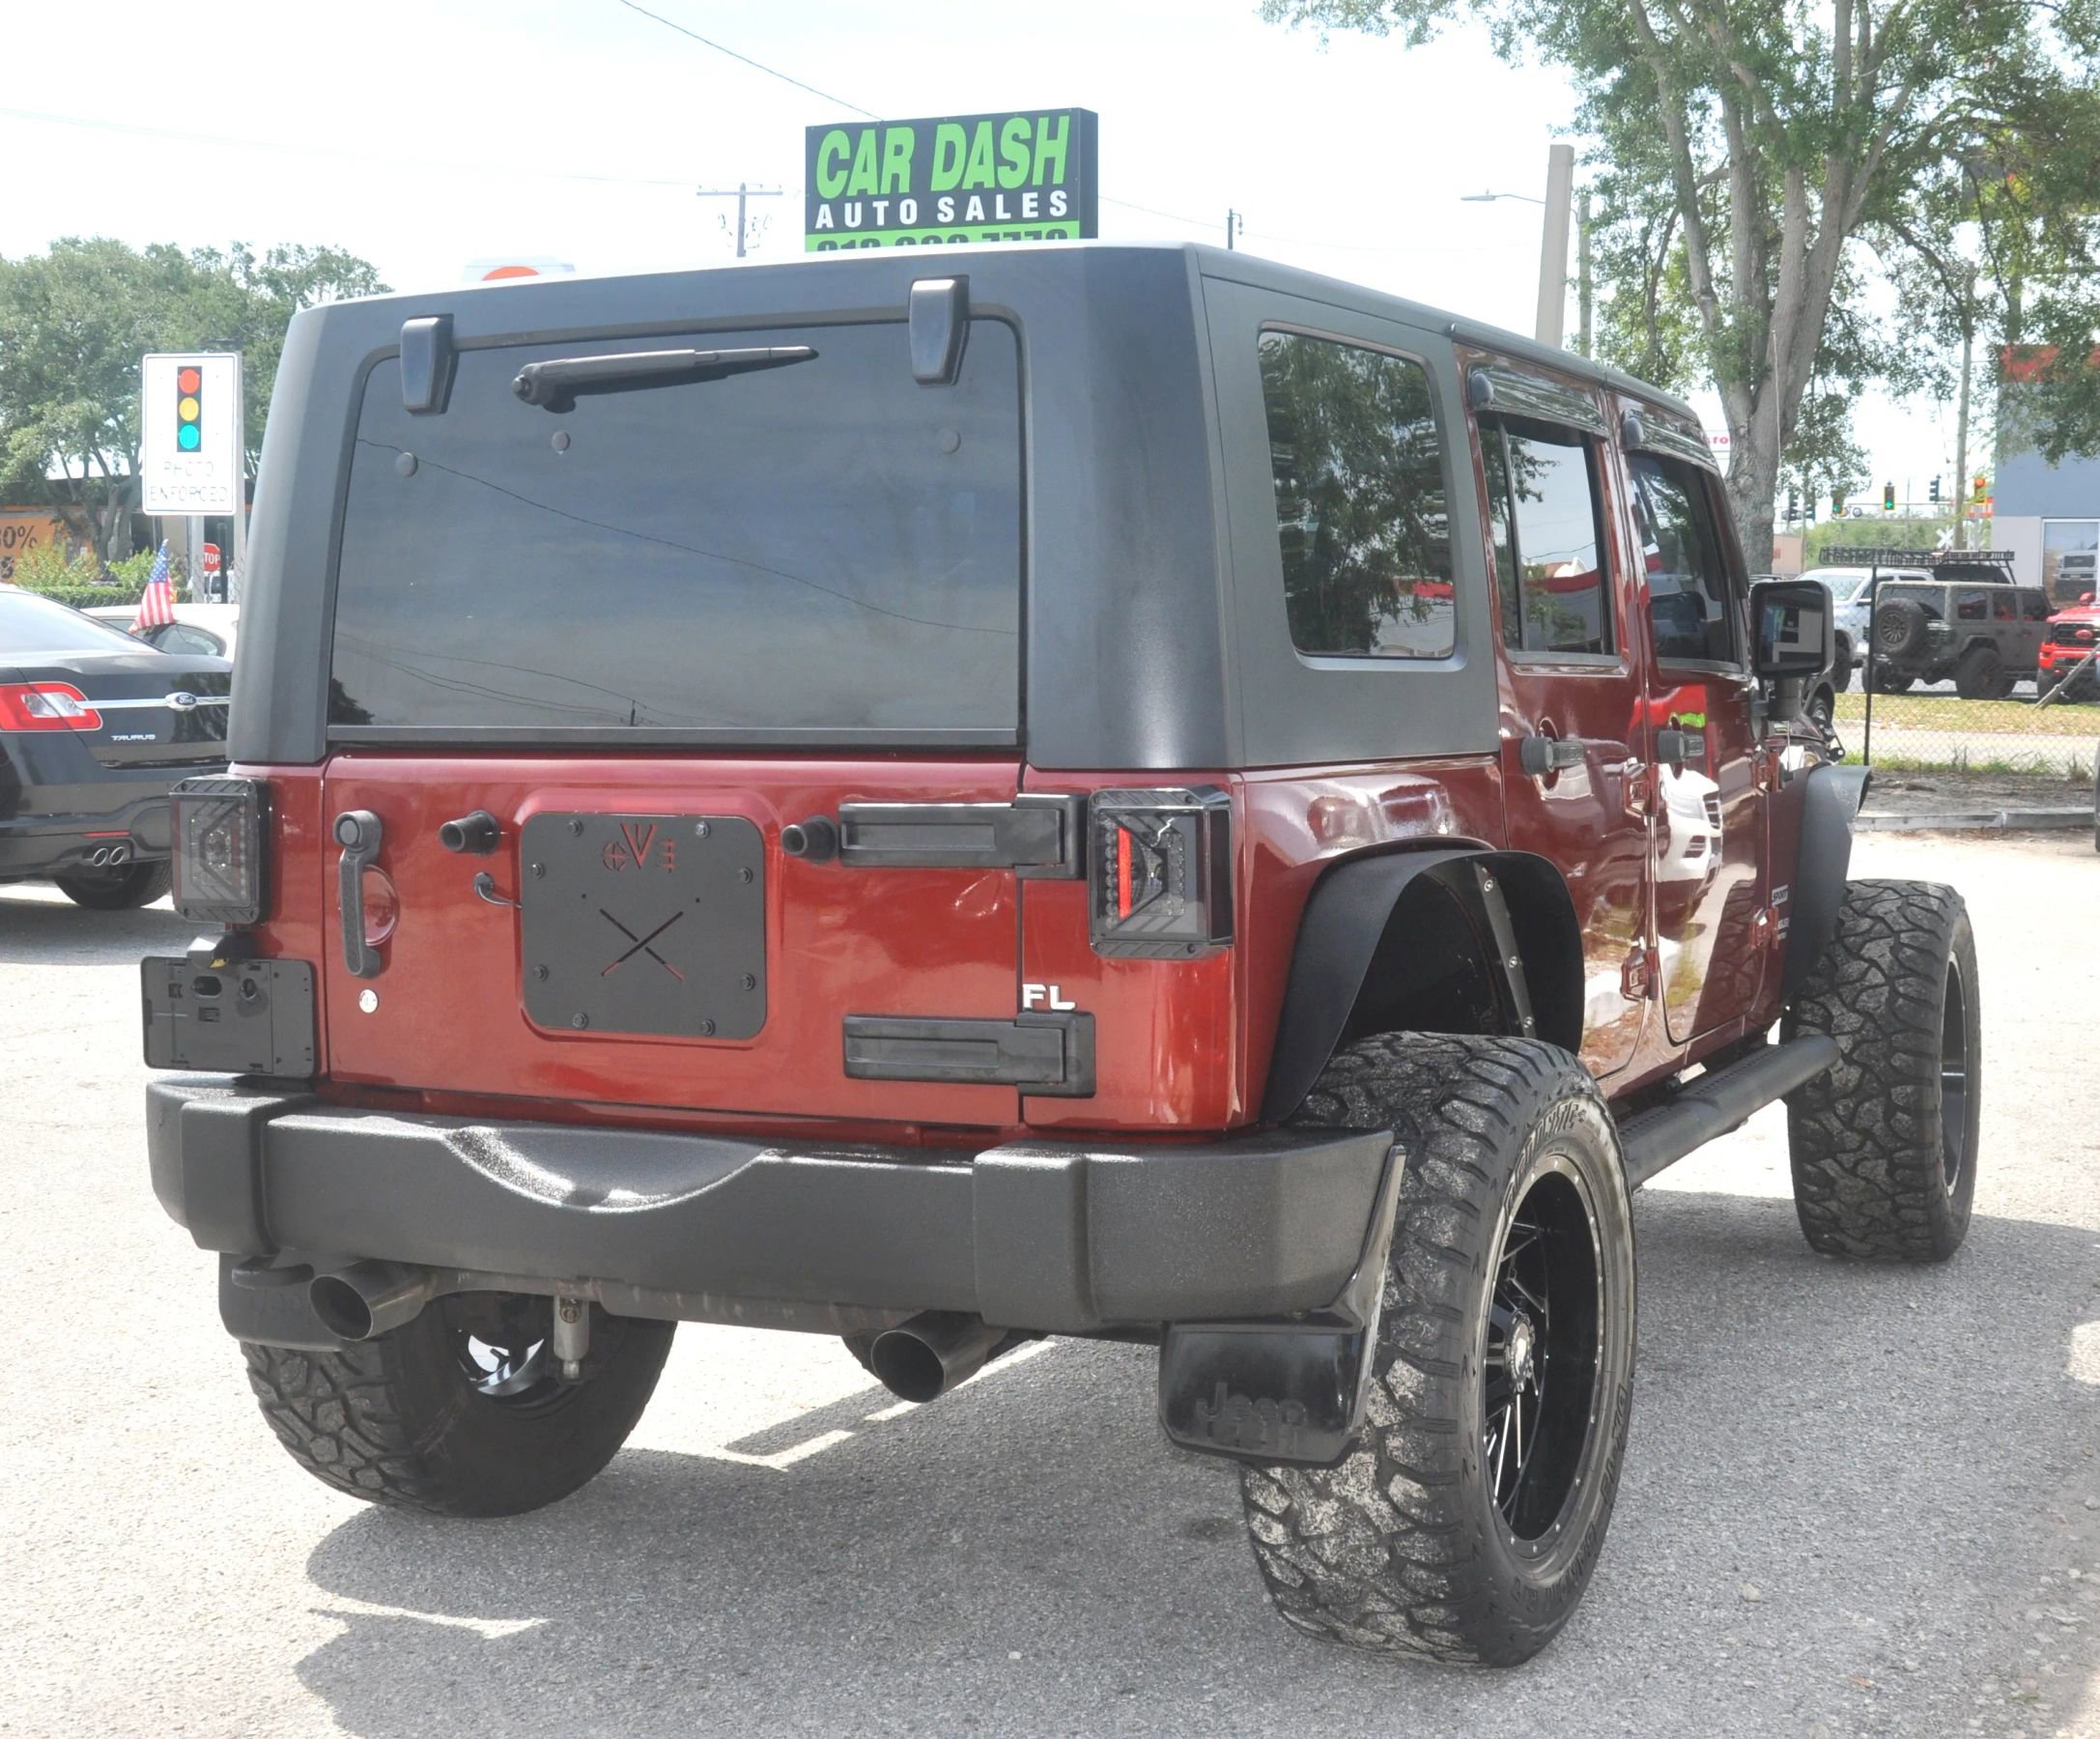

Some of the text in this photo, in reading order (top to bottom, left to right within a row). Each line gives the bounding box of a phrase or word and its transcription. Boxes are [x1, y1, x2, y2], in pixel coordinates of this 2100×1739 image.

[816, 115, 1070, 199] CAR DASH
[814, 190, 1067, 229] AUTO SALES
[163, 461, 215, 477] PHOTO
[150, 486, 228, 501] ENFORCED
[203, 552, 220, 564] TOP
[1022, 984, 1076, 1011] FL
